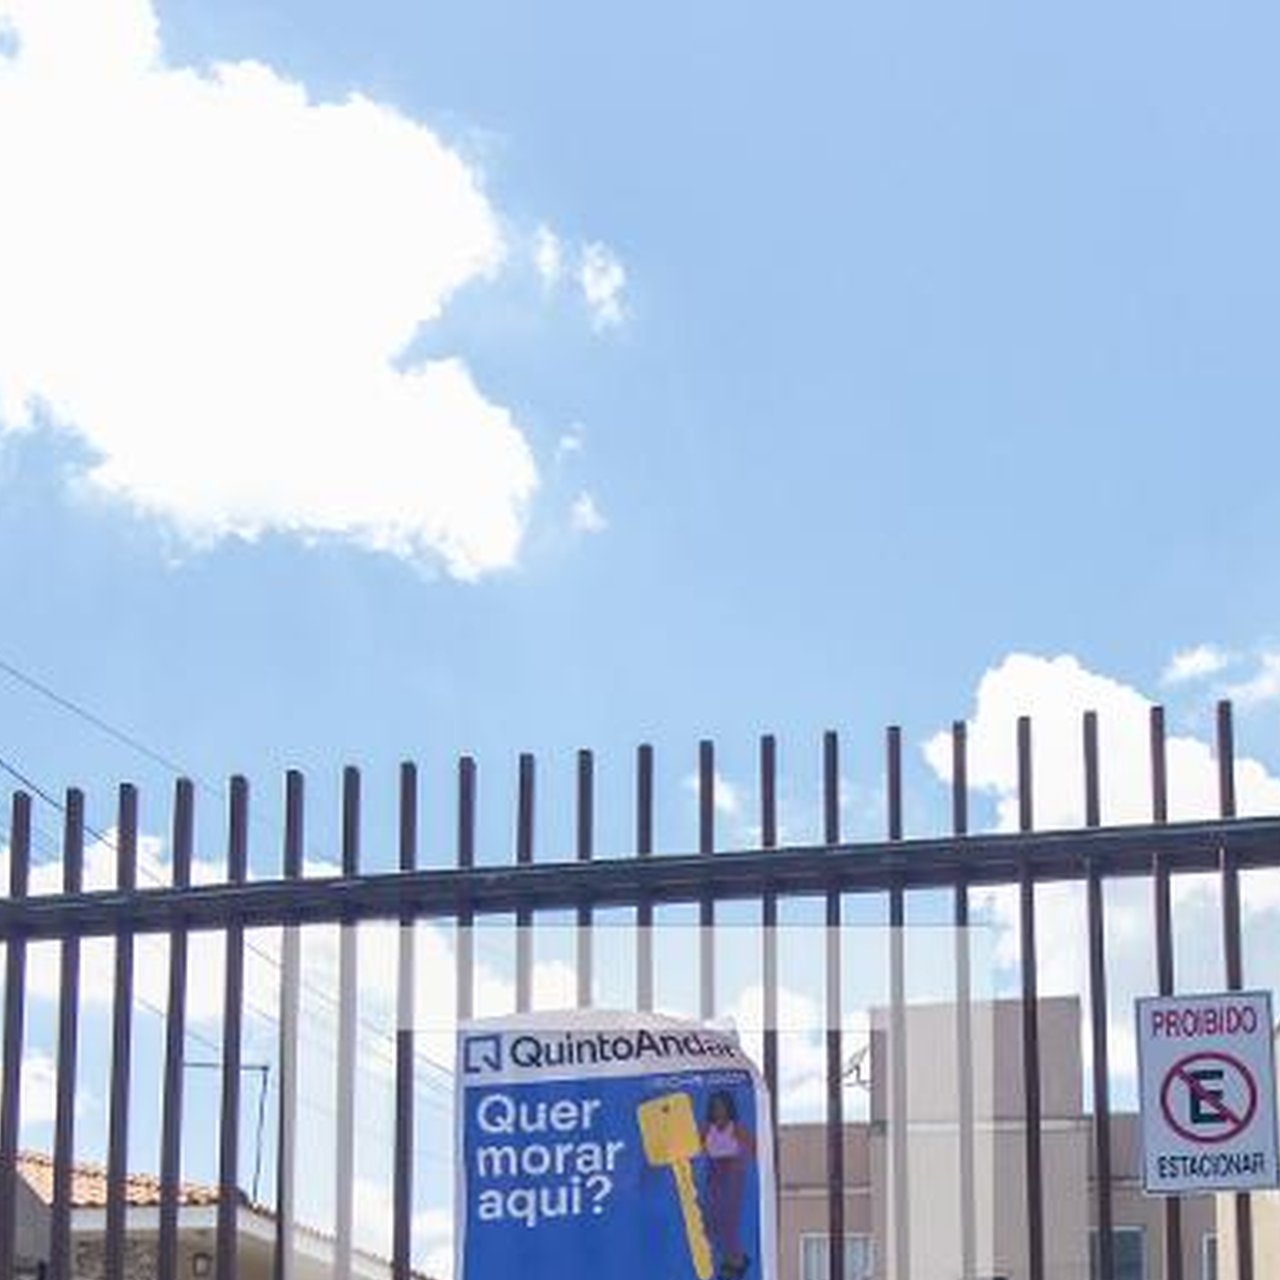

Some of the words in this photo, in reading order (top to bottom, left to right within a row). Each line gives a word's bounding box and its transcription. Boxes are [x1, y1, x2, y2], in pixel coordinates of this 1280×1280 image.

[1152, 1006, 1257, 1037] PROIBIDO
[478, 1093, 600, 1134] Quer
[478, 1139, 624, 1177] morar
[1158, 1152, 1265, 1179] ESTACIONAR
[478, 1176, 612, 1227] aqui?
